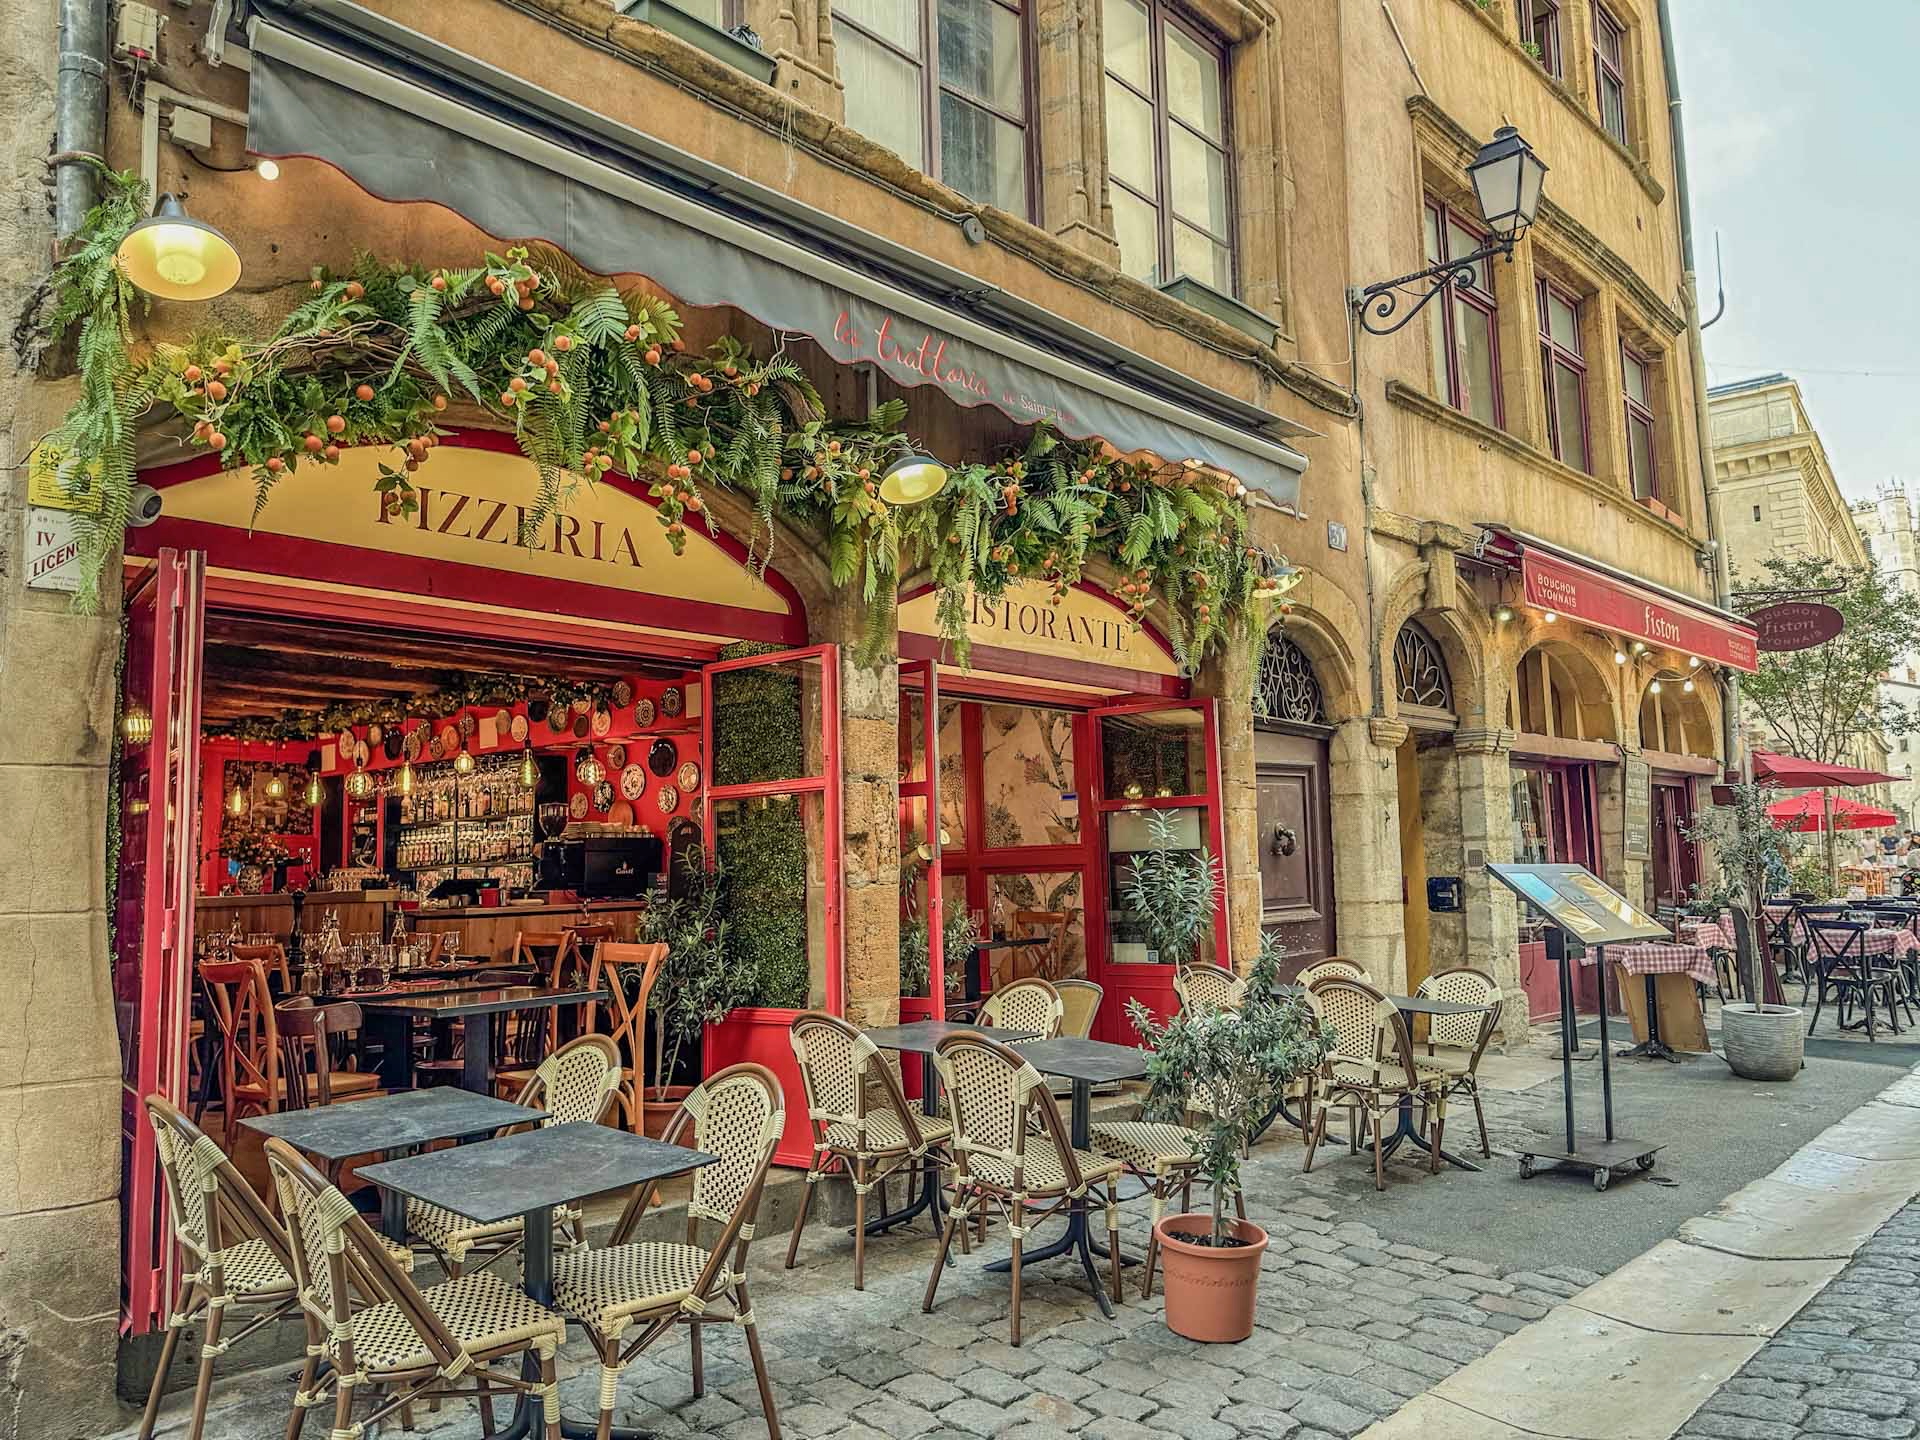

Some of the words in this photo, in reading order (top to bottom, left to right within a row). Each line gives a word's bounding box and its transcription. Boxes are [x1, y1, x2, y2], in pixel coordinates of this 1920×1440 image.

[874, 315, 991, 397] trattoria
[36, 530, 56, 547] IV
[33, 542, 80, 577] LICEN
[1537, 572, 1576, 596] BOUCHON
[1538, 585, 1577, 608] LYONNAIS
[960, 591, 1130, 653] ISTORANTE
[1644, 605, 1681, 643] fiston
[1763, 619, 1816, 637] fiston
